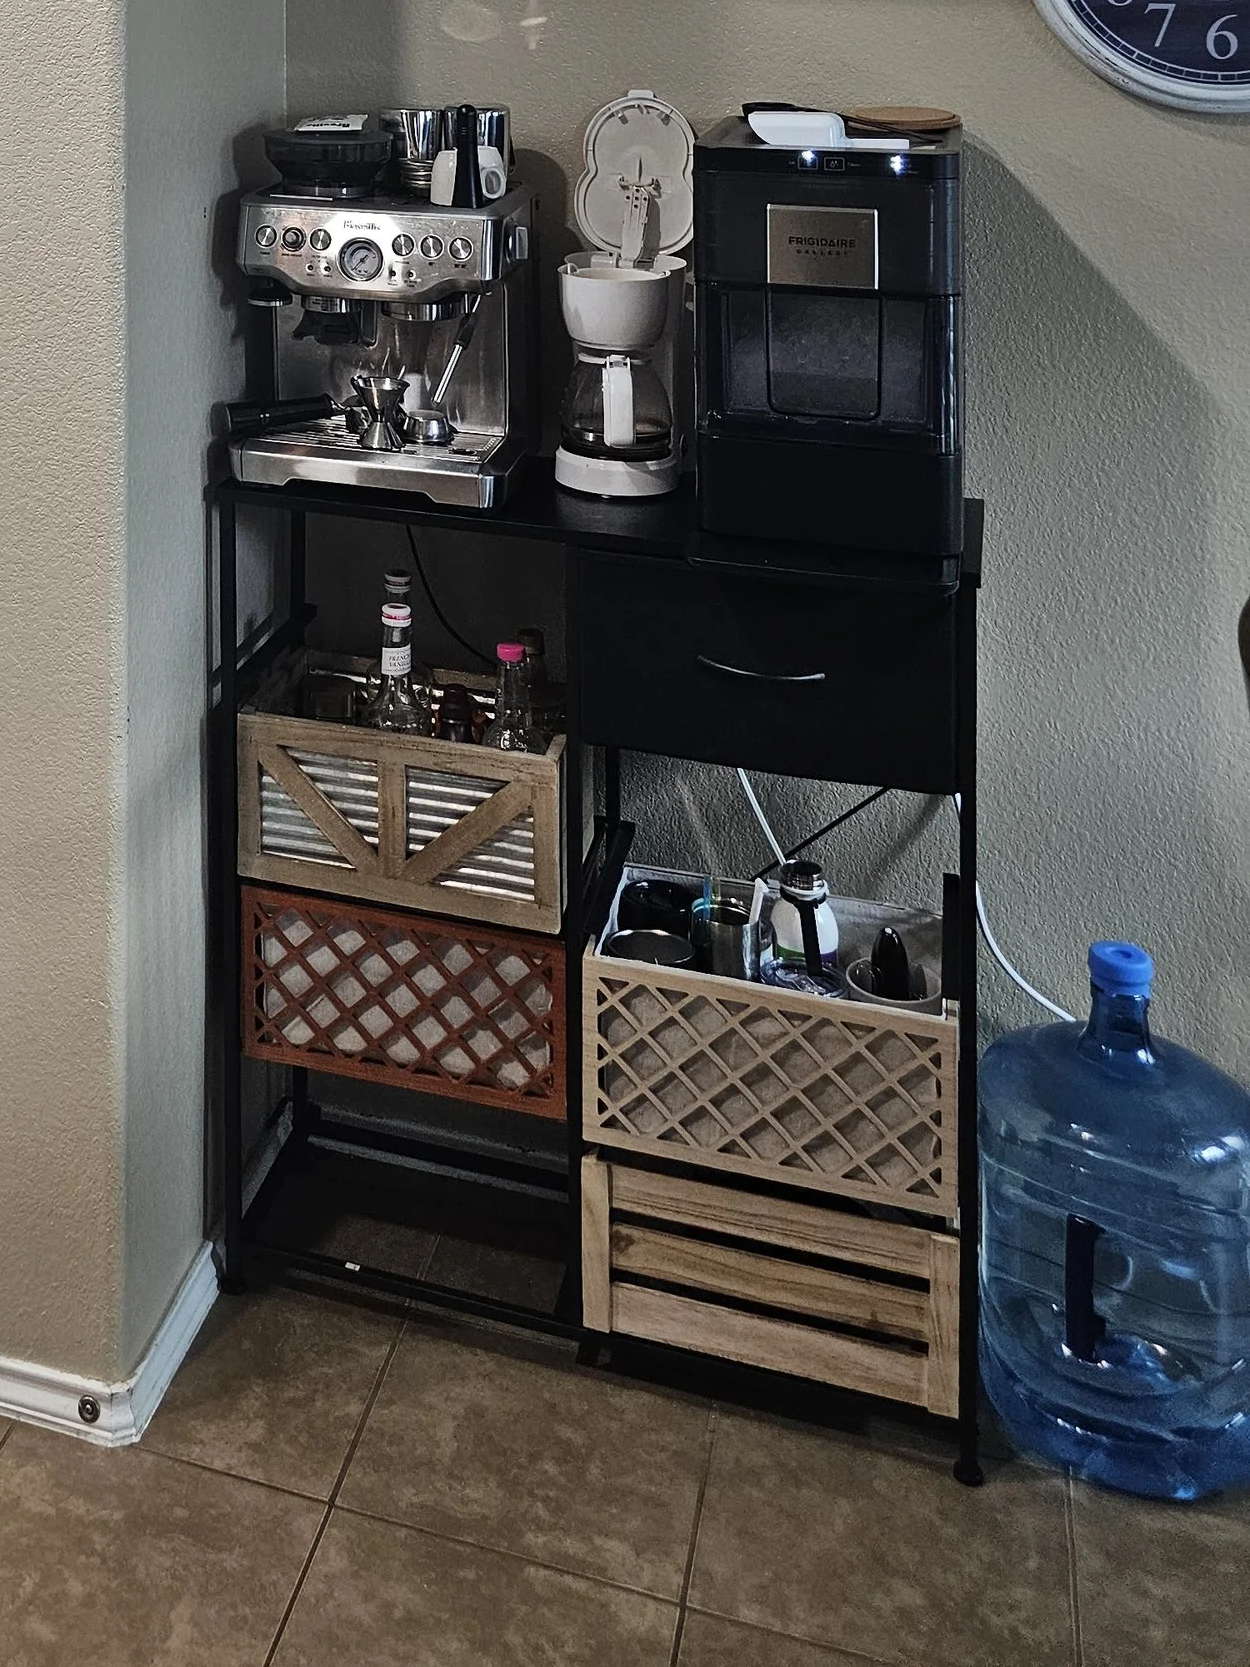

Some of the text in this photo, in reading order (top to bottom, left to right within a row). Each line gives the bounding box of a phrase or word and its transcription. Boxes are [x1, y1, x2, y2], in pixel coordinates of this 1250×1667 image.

[1144, 2, 1176, 48] 7
[1206, 14, 1239, 60] 6
[788, 236, 856, 248] FRIGIDAIRE
